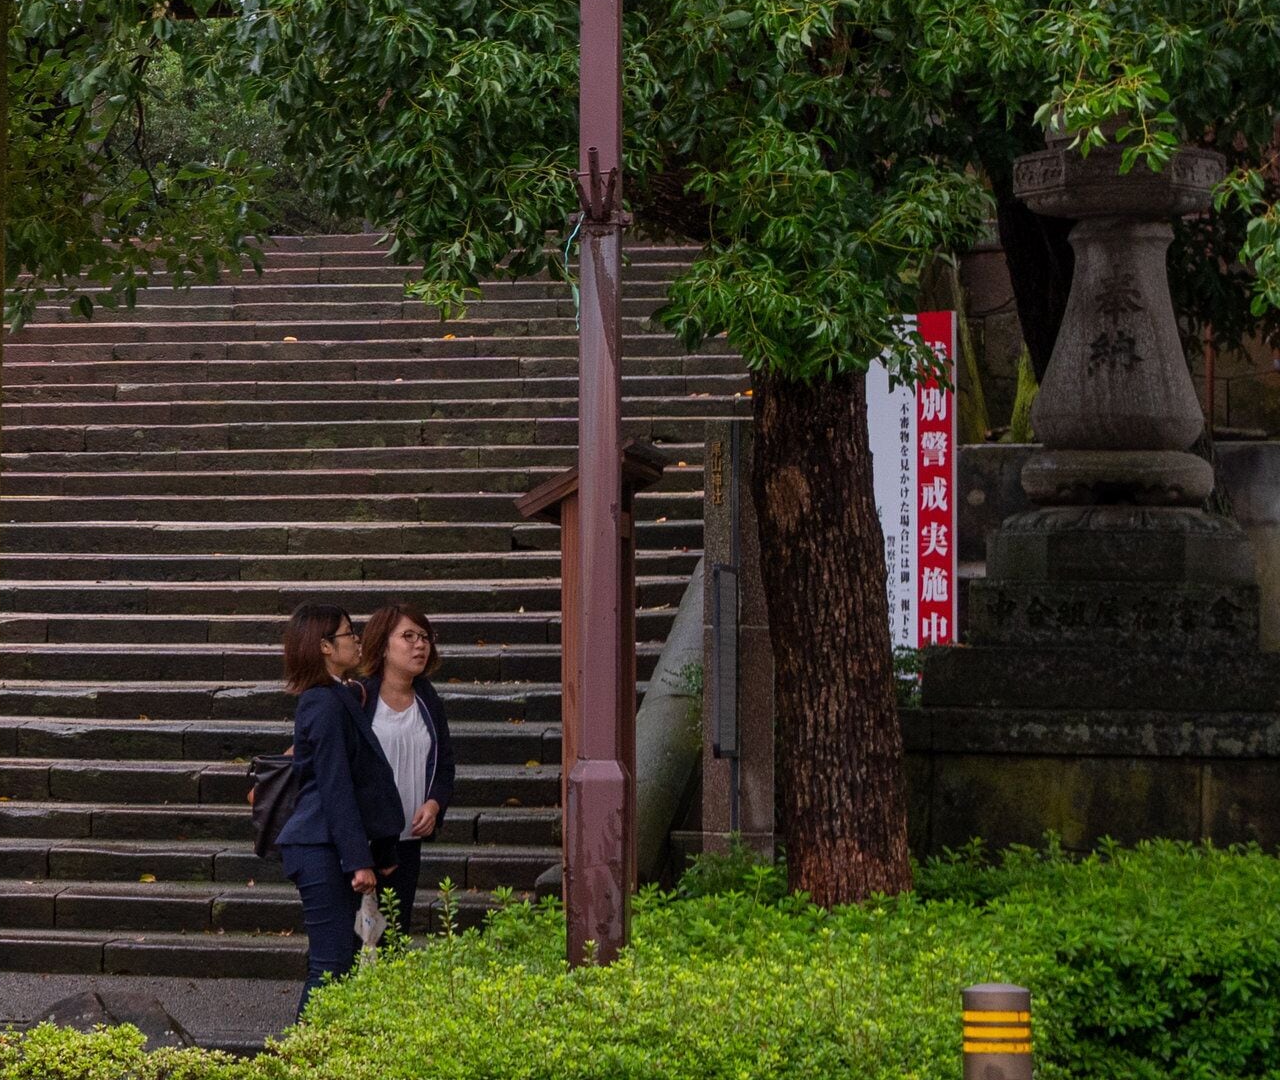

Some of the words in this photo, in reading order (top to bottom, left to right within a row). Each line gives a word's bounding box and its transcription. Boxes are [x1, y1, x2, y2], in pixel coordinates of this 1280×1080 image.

[899, 390, 910, 651] ・不審物を見かけた場合には御一報下さ
